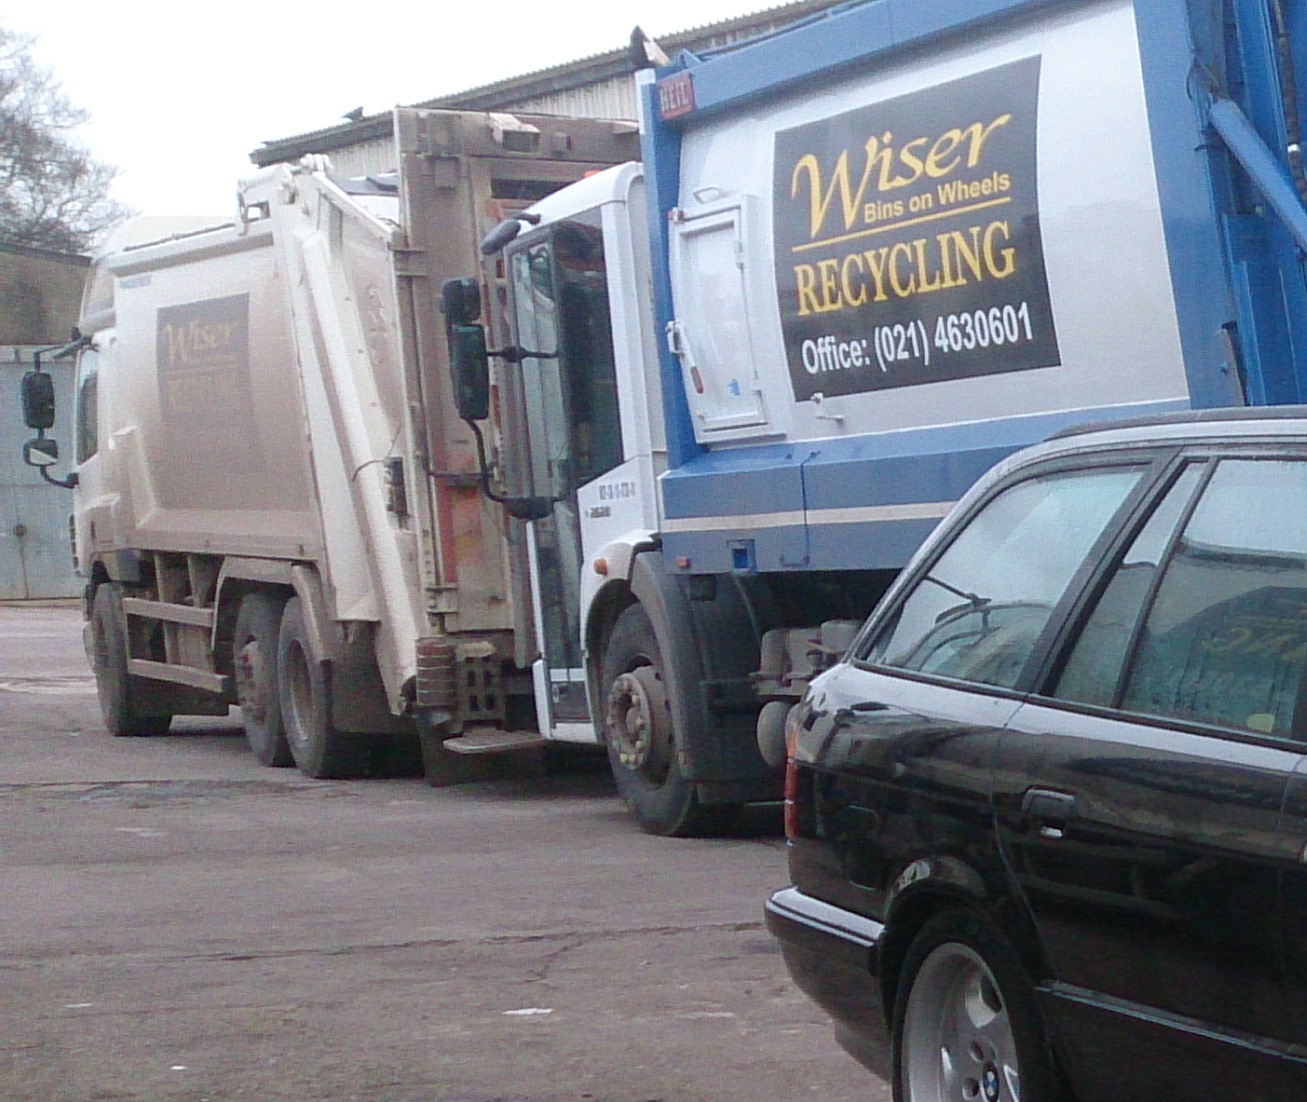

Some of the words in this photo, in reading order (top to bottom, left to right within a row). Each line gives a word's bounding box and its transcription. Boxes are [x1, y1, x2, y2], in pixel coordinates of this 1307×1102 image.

[791, 114, 1012, 238] Wiser
[864, 201, 904, 223] Bins
[909, 192, 932, 212] on
[937, 172, 1011, 205] Wheels
[794, 221, 1016, 316] RECYCLING
[802, 336, 870, 374] Office:
[874, 320, 930, 372] (021)
[935, 302, 1032, 353] 4630601
